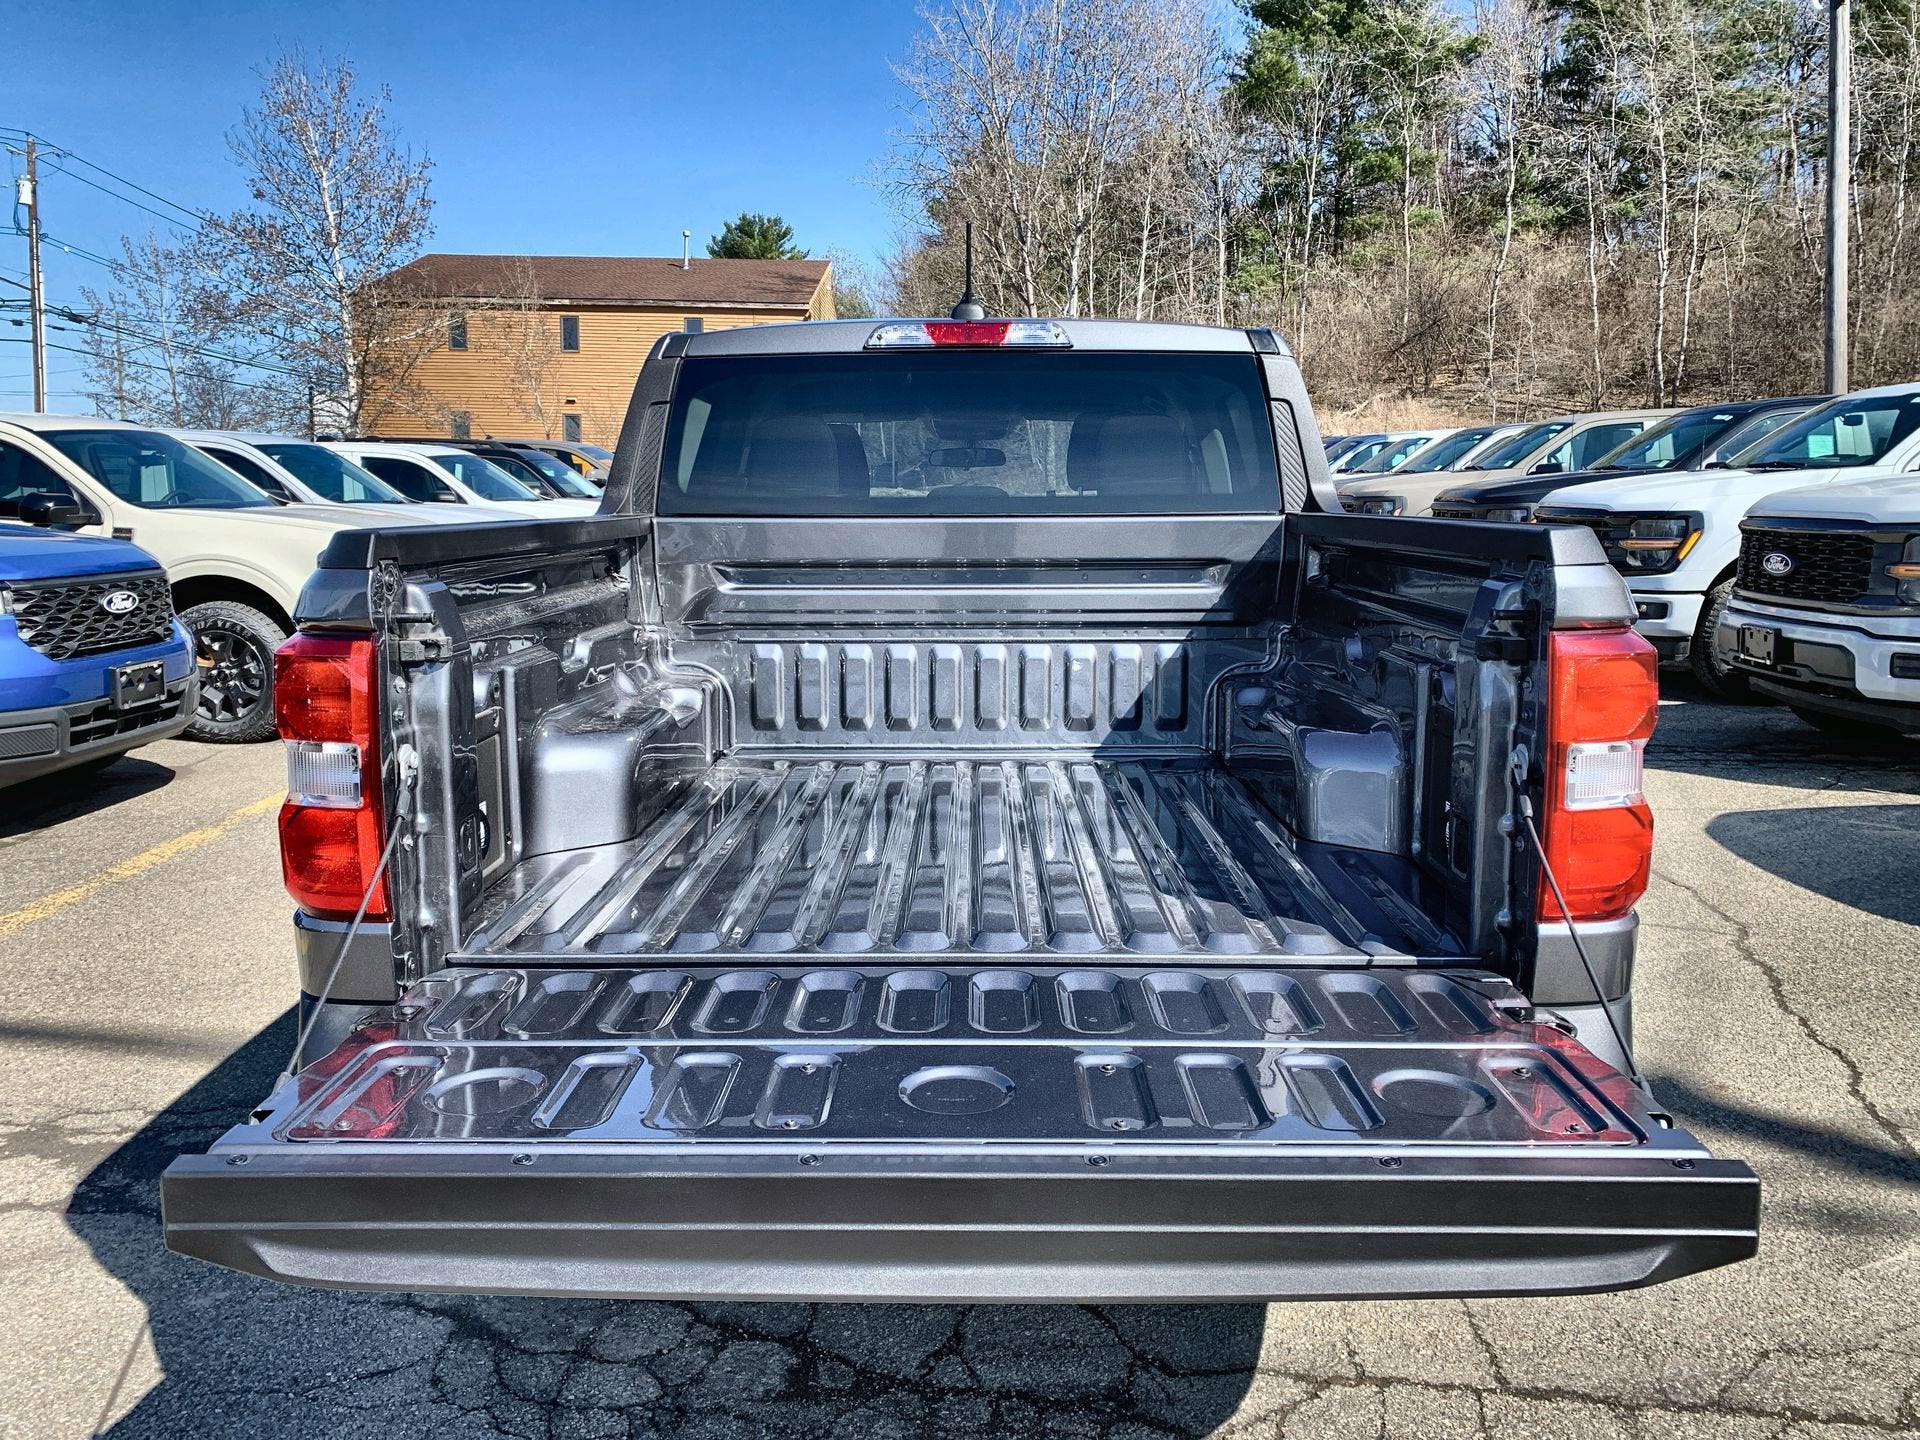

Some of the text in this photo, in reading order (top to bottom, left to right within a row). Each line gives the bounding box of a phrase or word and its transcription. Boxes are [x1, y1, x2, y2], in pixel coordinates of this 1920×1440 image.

[1766, 555, 1787, 571] Ford
[108, 593, 134, 611] Ford
[190, 619, 252, 639] ODYEAR
